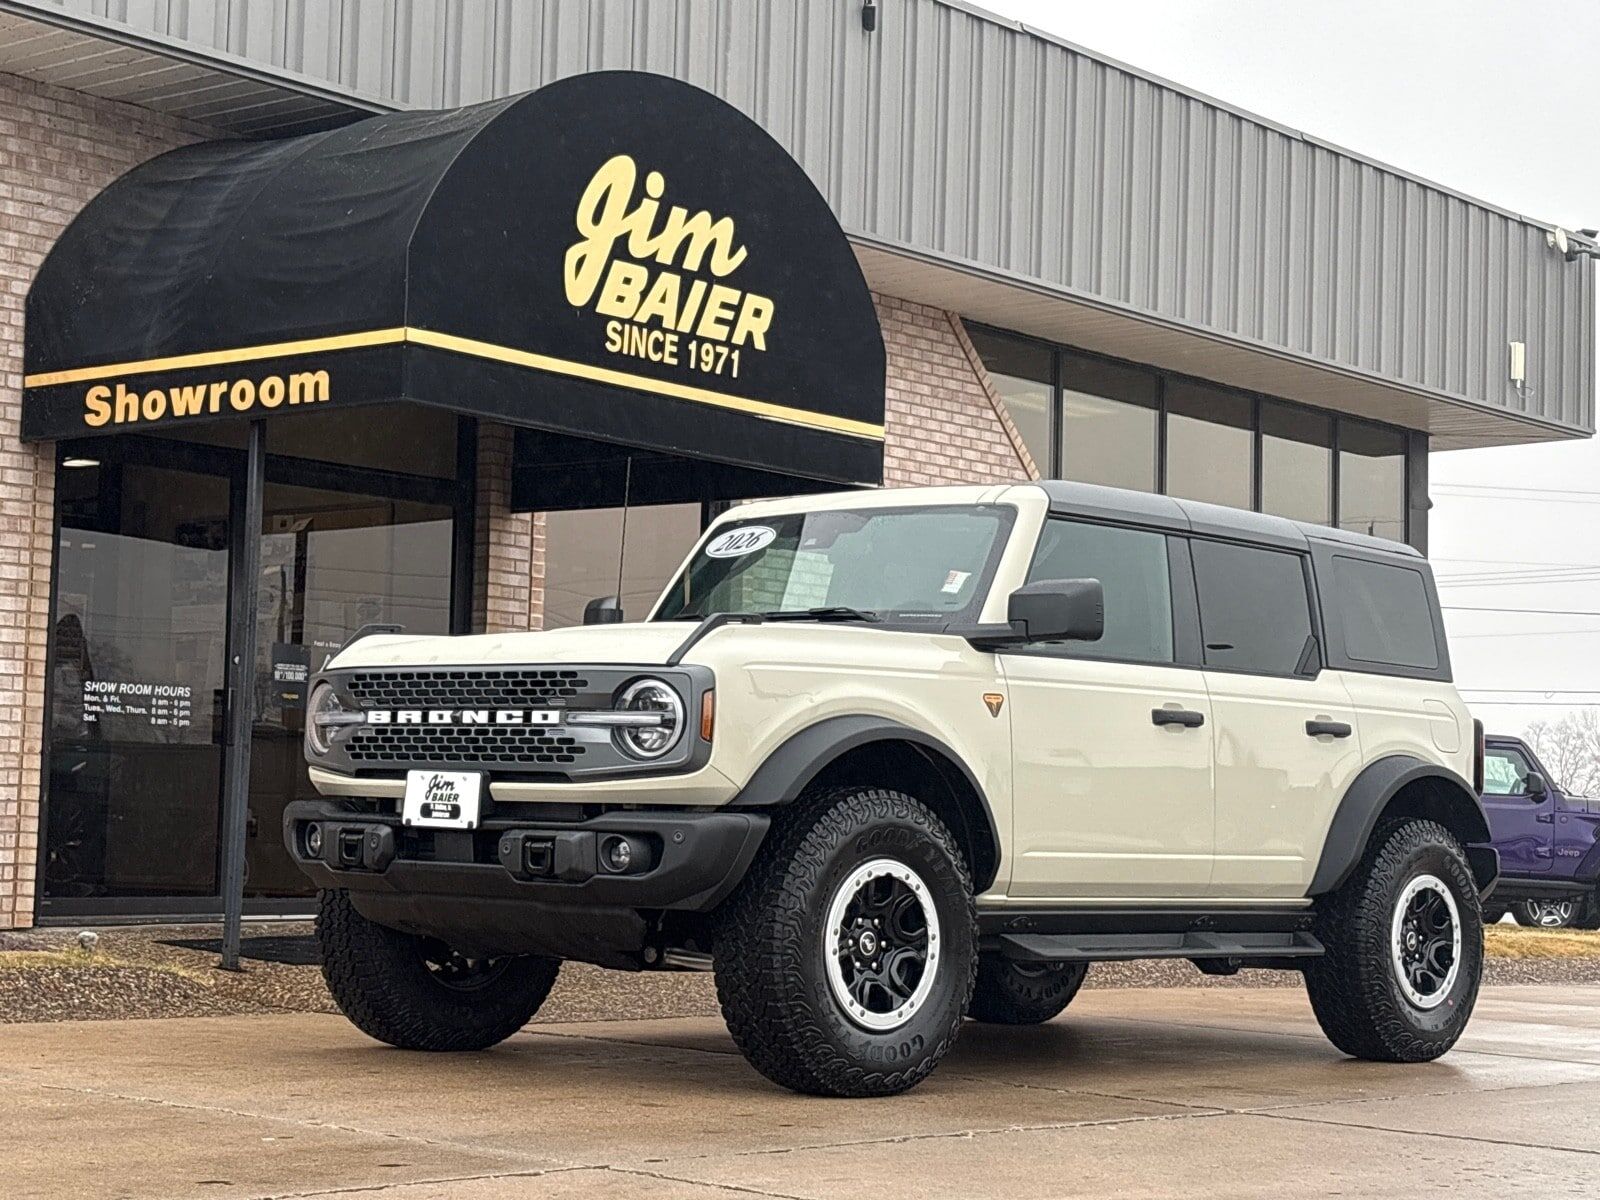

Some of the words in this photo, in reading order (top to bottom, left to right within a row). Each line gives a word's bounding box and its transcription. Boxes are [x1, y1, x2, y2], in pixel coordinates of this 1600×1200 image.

[564, 155, 748, 306] Jim
[595, 260, 775, 351] BAIER
[605, 320, 679, 366] SINCE
[688, 340, 740, 379] 1971
[84, 370, 330, 427] Showroom
[713, 531, 769, 553] 2026
[84, 681, 117, 693] SHOW
[119, 683, 152, 696] ROOM
[154, 685, 191, 698] HOURS
[157, 708, 169, 716] am
[179, 709, 191, 718] pm
[179, 700, 191, 709] pm
[156, 718, 168, 726] am
[178, 719, 190, 728] pm
[367, 710, 560, 724] BRONCO
[425, 774, 456, 801] Jim
[432, 792, 460, 803] BAIER
[1556, 847, 1580, 858] Jeep
